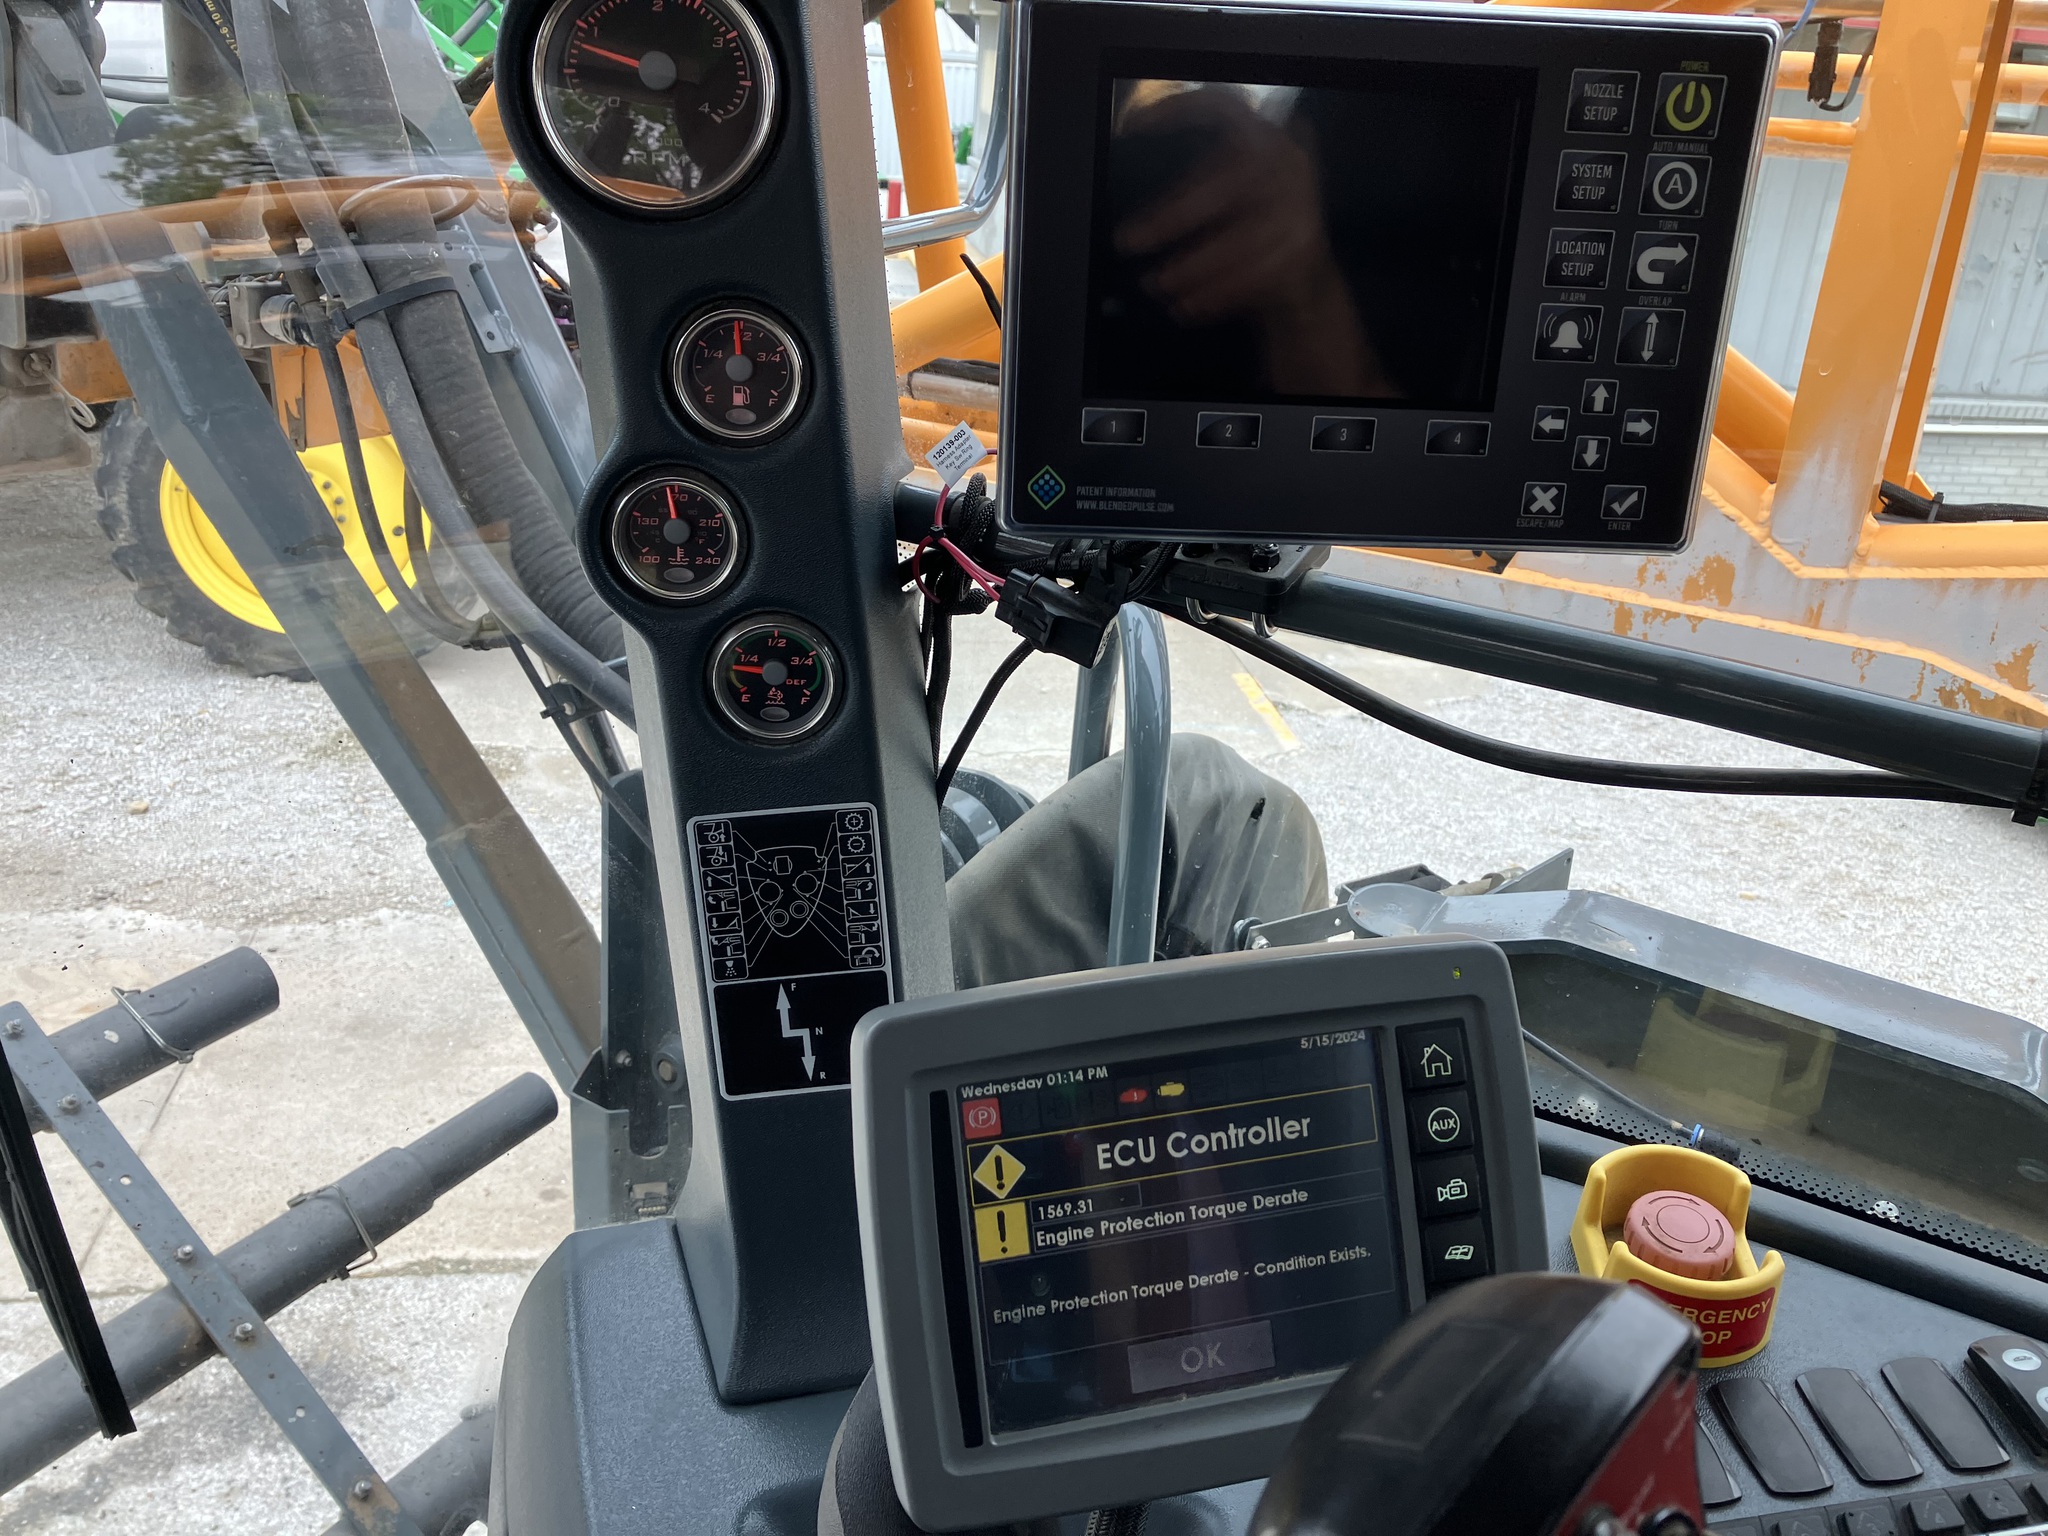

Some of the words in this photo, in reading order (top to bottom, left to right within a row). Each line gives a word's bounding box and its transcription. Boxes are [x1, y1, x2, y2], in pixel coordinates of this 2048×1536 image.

[652, 1, 663, 11] 2
[593, 27, 598, 37] 1
[713, 37, 723, 48] 3
[1680, 60, 1710, 72] POWER
[1583, 83, 1624, 98] NOZZLE
[608, 96, 620, 107] 0
[699, 102, 710, 113] 4
[1583, 106, 1618, 120] SETUP
[632, 152, 687, 167] RPM
[1572, 164, 1612, 178] SYSTEM
[1664, 173, 1684, 194] A
[1572, 186, 1606, 200] SETUP
[1658, 220, 1678, 230] TURN
[1555, 241, 1606, 256] LOCATION
[1561, 262, 1594, 276] SETUP
[1560, 292, 1586, 302] ALARM
[1638, 296, 1672, 306] OVERLAP
[733, 332, 752, 341] /2
[704, 350, 723, 359] 1/4
[757, 352, 780, 362] 3/4
[706, 394, 715, 403] E
[769, 398, 778, 407] F
[1111, 420, 1116, 432] 1
[1226, 424, 1233, 438] 2
[1340, 428, 1347, 440] 3
[1454, 432, 1461, 444] 4
[932, 430, 966, 461] 120139-003
[1077, 486, 1103, 496] PATENT
[1106, 487, 1156, 498] INFORMATION
[1516, 518, 1564, 529] ESCAPE/MAP
[1608, 522, 1631, 531] ENTER
[640, 556, 660, 564] 100
[768, 638, 786, 647] 1/2
[740, 654, 758, 662] 1/4
[790, 657, 813, 666] 3/4
[742, 694, 750, 702] E
[791, 983, 796, 991] F
[816, 1026, 824, 1036] N
[1301, 1030, 1366, 1049] 5/15/2024
[820, 1072, 826, 1080] R
[961, 1076, 1044, 1098] Wednesday
[1047, 1069, 1085, 1086] 01:14
[1088, 1066, 1108, 1080] PM
[1432, 1118, 1456, 1132] AUX
[1096, 1136, 1156, 1170] ECU
[1167, 1116, 1312, 1158] Controller
[1038, 1199, 1094, 1220] 1569.31
[1036, 1224, 1094, 1250] Engine
[1100, 1208, 1186, 1236] Protection
[1190, 1199, 1248, 1222] Torque
[1253, 1188, 1308, 1210] Derate
[993, 1302, 1046, 1325] Engine
[1050, 1287, 1128, 1314] Protection
[1132, 1278, 1184, 1300] Torque
[1188, 1268, 1239, 1290] Derate
[1254, 1253, 1326, 1276] Condition
[1330, 1244, 1372, 1264] Exists.
[1669, 1298, 1771, 1324] RGENCY
[1701, 1330, 1732, 1344] OP
[1180, 1342, 1226, 1373] OK
